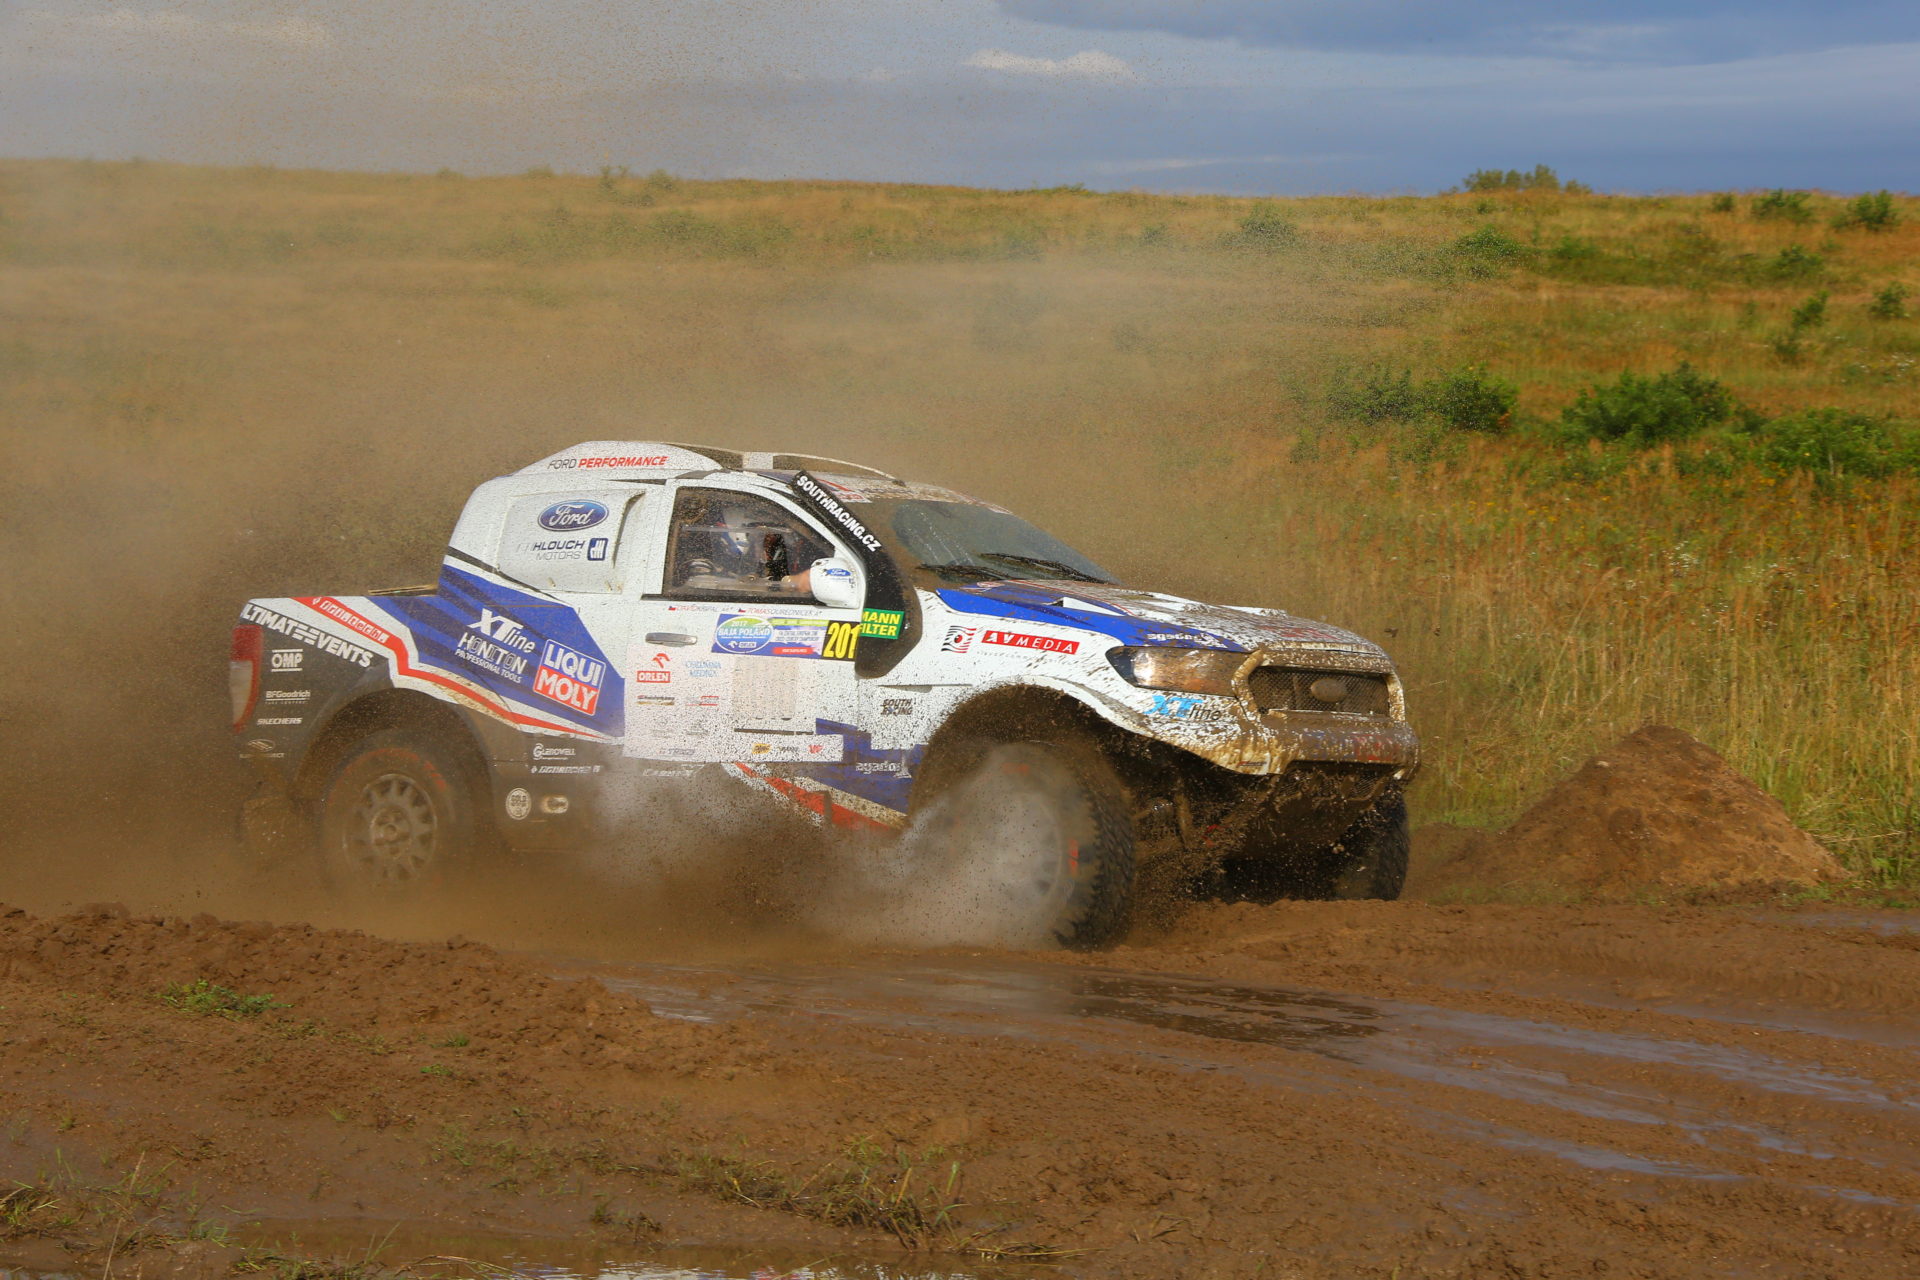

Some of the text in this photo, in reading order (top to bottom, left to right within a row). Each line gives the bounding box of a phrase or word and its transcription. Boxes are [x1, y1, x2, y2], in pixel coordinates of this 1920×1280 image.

[547, 456, 669, 469] FORD PERFORMANCE
[548, 503, 595, 527] Ford
[796, 475, 882, 552] SOUTHRACING.CZ
[533, 540, 586, 551] HLOUCH
[536, 551, 582, 561] MOTORS
[467, 608, 536, 653] XTline
[719, 627, 771, 637] BAJA POLAND
[823, 621, 861, 659] 201
[271, 653, 303, 668] OMP
[457, 632, 528, 675] HONITON
[454, 648, 523, 684] PROFESSIONAL TOOLS
[543, 643, 602, 687] LIQUI
[638, 672, 669, 681] ORLEN
[265, 689, 311, 698] BFGoodrich
[536, 669, 598, 711] MOLY
[882, 698, 913, 706] SOUTH
[256, 717, 303, 725] SKECHERS
